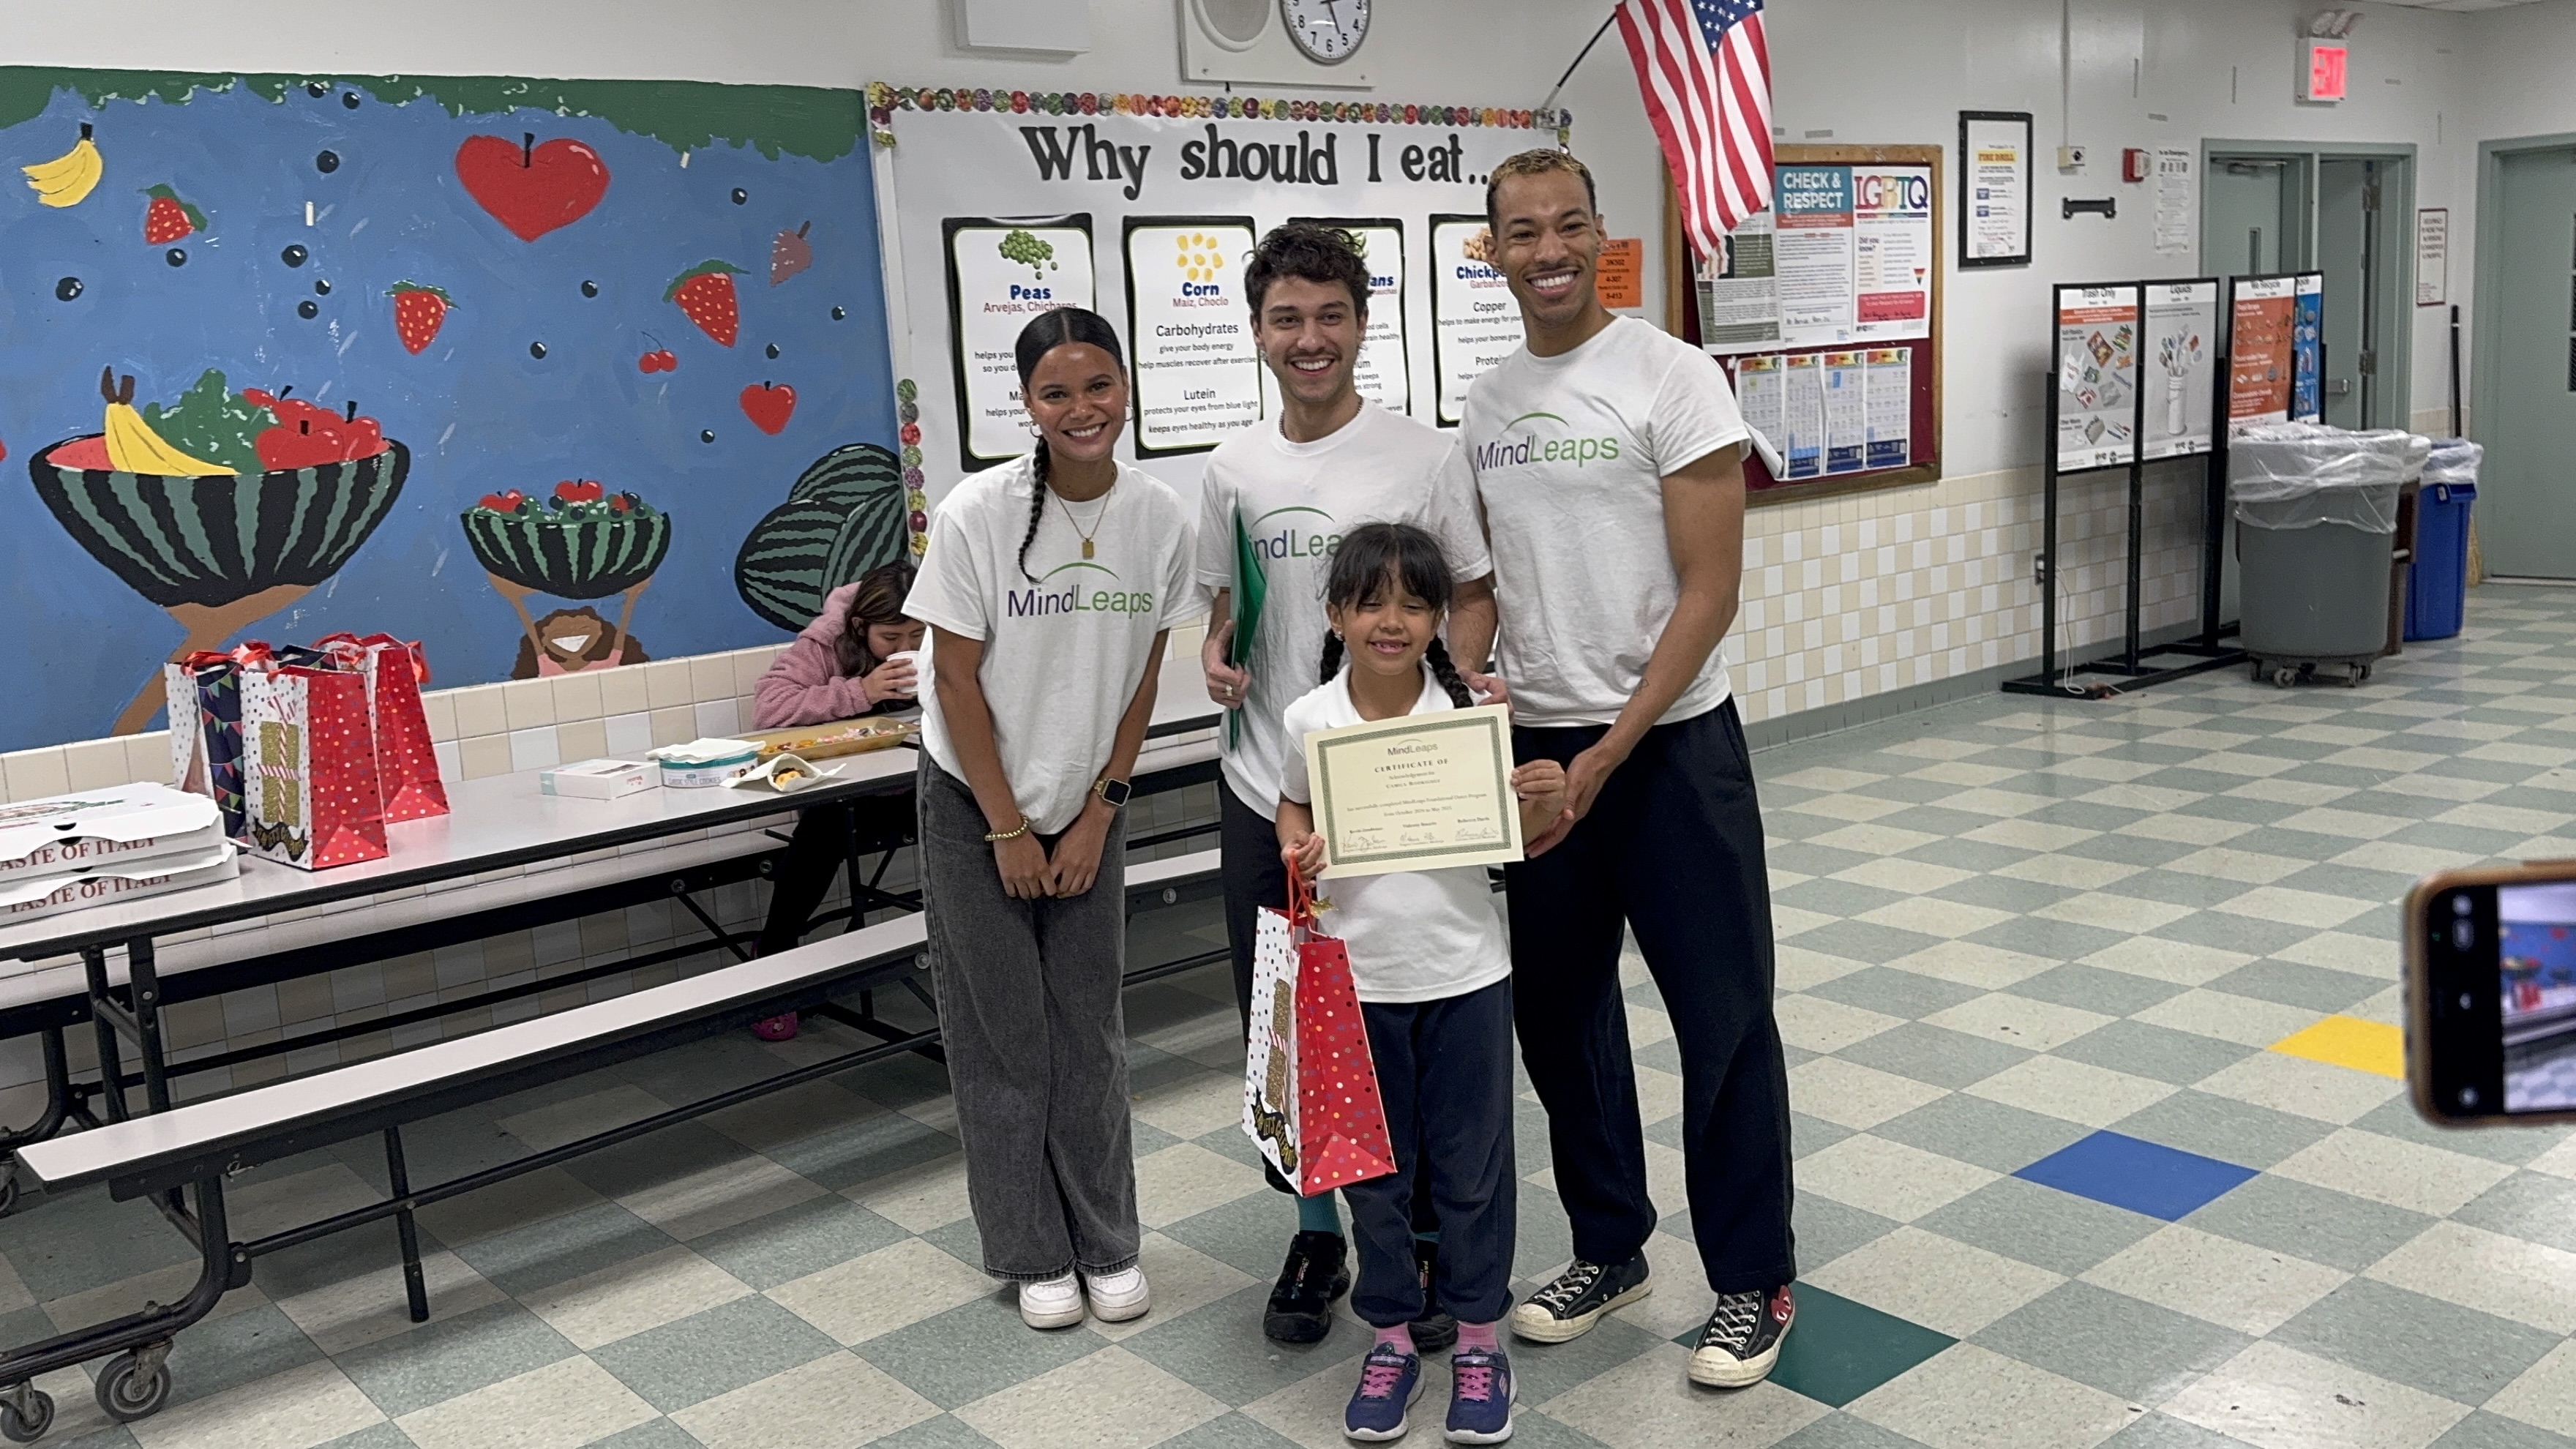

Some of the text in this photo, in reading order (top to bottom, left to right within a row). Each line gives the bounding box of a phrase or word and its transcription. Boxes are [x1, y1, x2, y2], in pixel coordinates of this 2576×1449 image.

[1298, 15, 1305, 29] 8
[1352, 18, 1359, 32] 4
[1311, 31, 1317, 45] 7
[1342, 33, 1349, 46] 5
[1326, 39, 1333, 52] 6
[1019, 123, 1151, 201] Why
[1180, 123, 1338, 185] should
[1367, 133, 1382, 182] I
[1783, 172, 1841, 189] CHECK &
[1854, 175, 1928, 210] LGBTQ
[1783, 192, 1844, 209] RESPECT
[1010, 285, 1051, 300] Peas
[1182, 282, 1219, 296] Corn
[984, 302, 1026, 315] Arvejas,
[1198, 296, 1229, 307] Choclo
[1473, 302, 1506, 314] Copper
[1438, 318, 1455, 327] helps
[1156, 323, 1239, 338] Carbohydrates
[1475, 336, 1489, 344] your
[1159, 342, 1234, 354] give your body energy
[974, 351, 1014, 361] helps you
[1475, 354, 1509, 366] Protei
[993, 365, 1008, 374] you
[1138, 361, 1154, 370] help
[1156, 360, 1183, 368] muscles
[1213, 357, 1229, 365] after
[1183, 388, 1216, 400] Lutein
[986, 408, 1026, 418] helps your
[1144, 400, 1258, 417] protects your eyes from blue light
[1148, 425, 1170, 434] keeps
[1172, 425, 1188, 433] eyes
[1188, 422, 1216, 430] healthy
[1227, 421, 1240, 429] you
[1241, 419, 1253, 428] age
[1476, 435, 1620, 472] MindLeaps
[1008, 584, 1153, 620] MindLeaps
[1388, 742, 1438, 756] MindLeaps
[1374, 760, 1433, 773] CERTIFICATE
[61, 842, 90, 861] OF
[96, 837, 156, 855] ITALY
[11, 887, 75, 914] TASTE
[80, 880, 108, 899] OF
